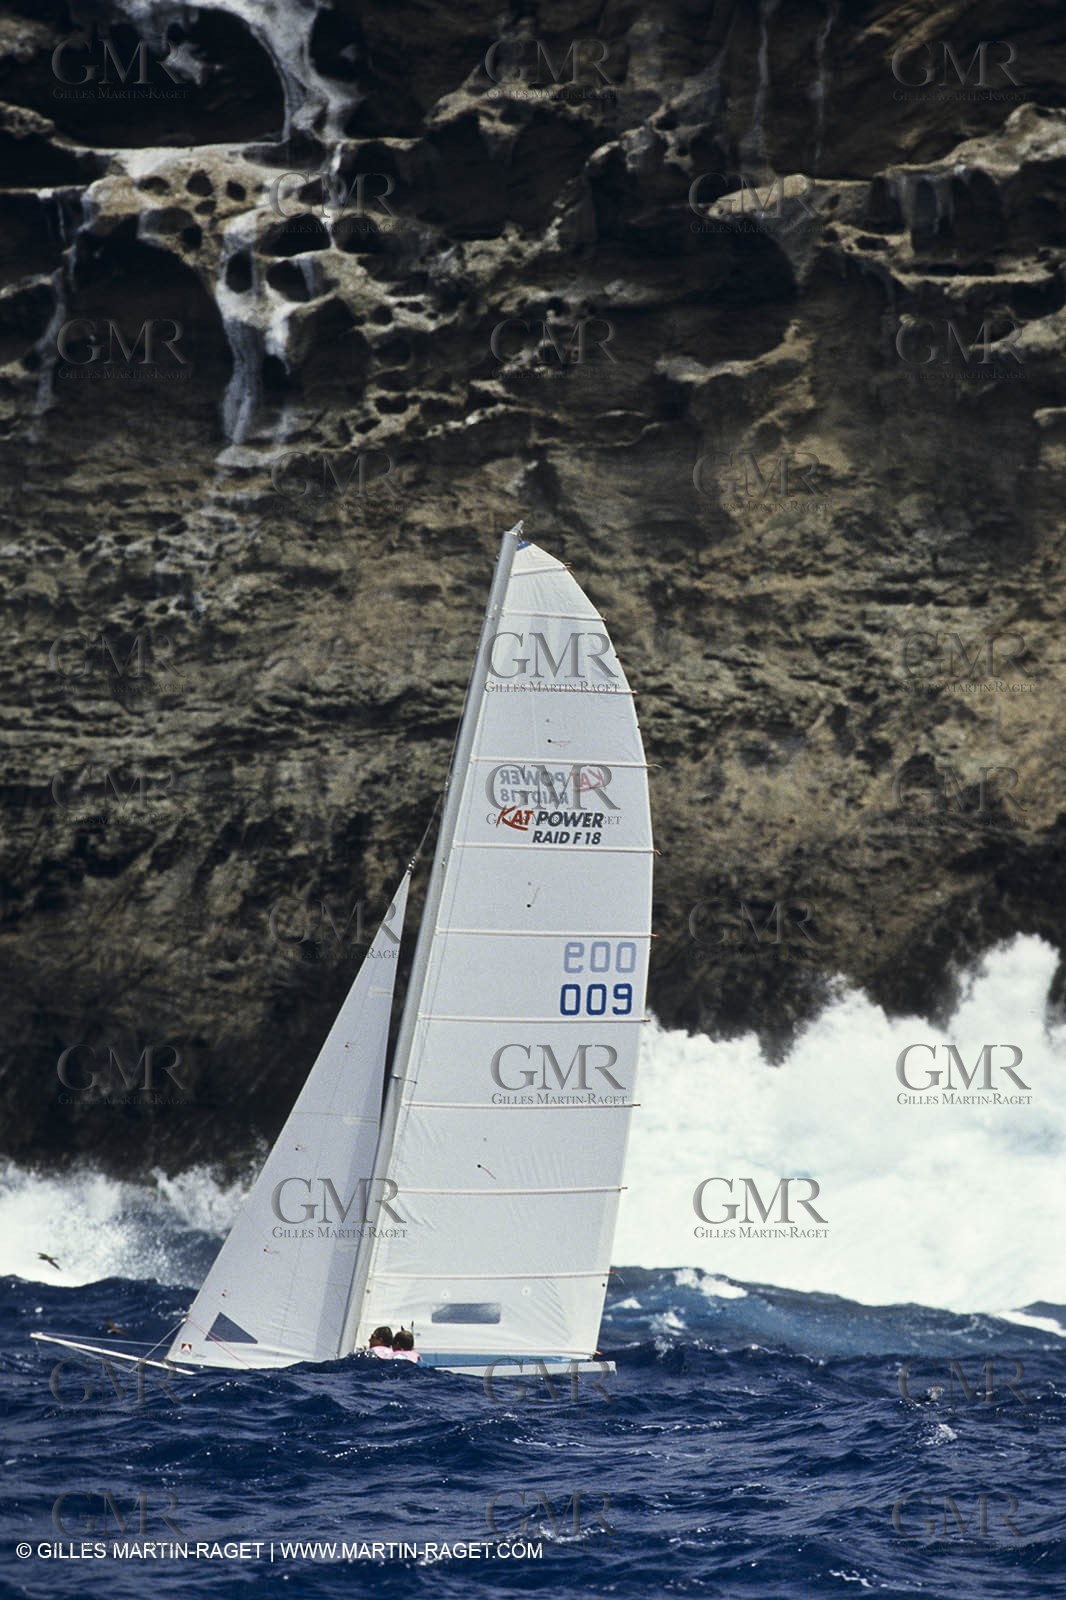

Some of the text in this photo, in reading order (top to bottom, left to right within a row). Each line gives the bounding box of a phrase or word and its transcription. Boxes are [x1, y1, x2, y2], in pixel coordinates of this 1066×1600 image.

[496, 805, 534, 831] KAT
[536, 810, 604, 829] POWER
[532, 830, 570, 844] RAID
[560, 983, 633, 1016] 009
